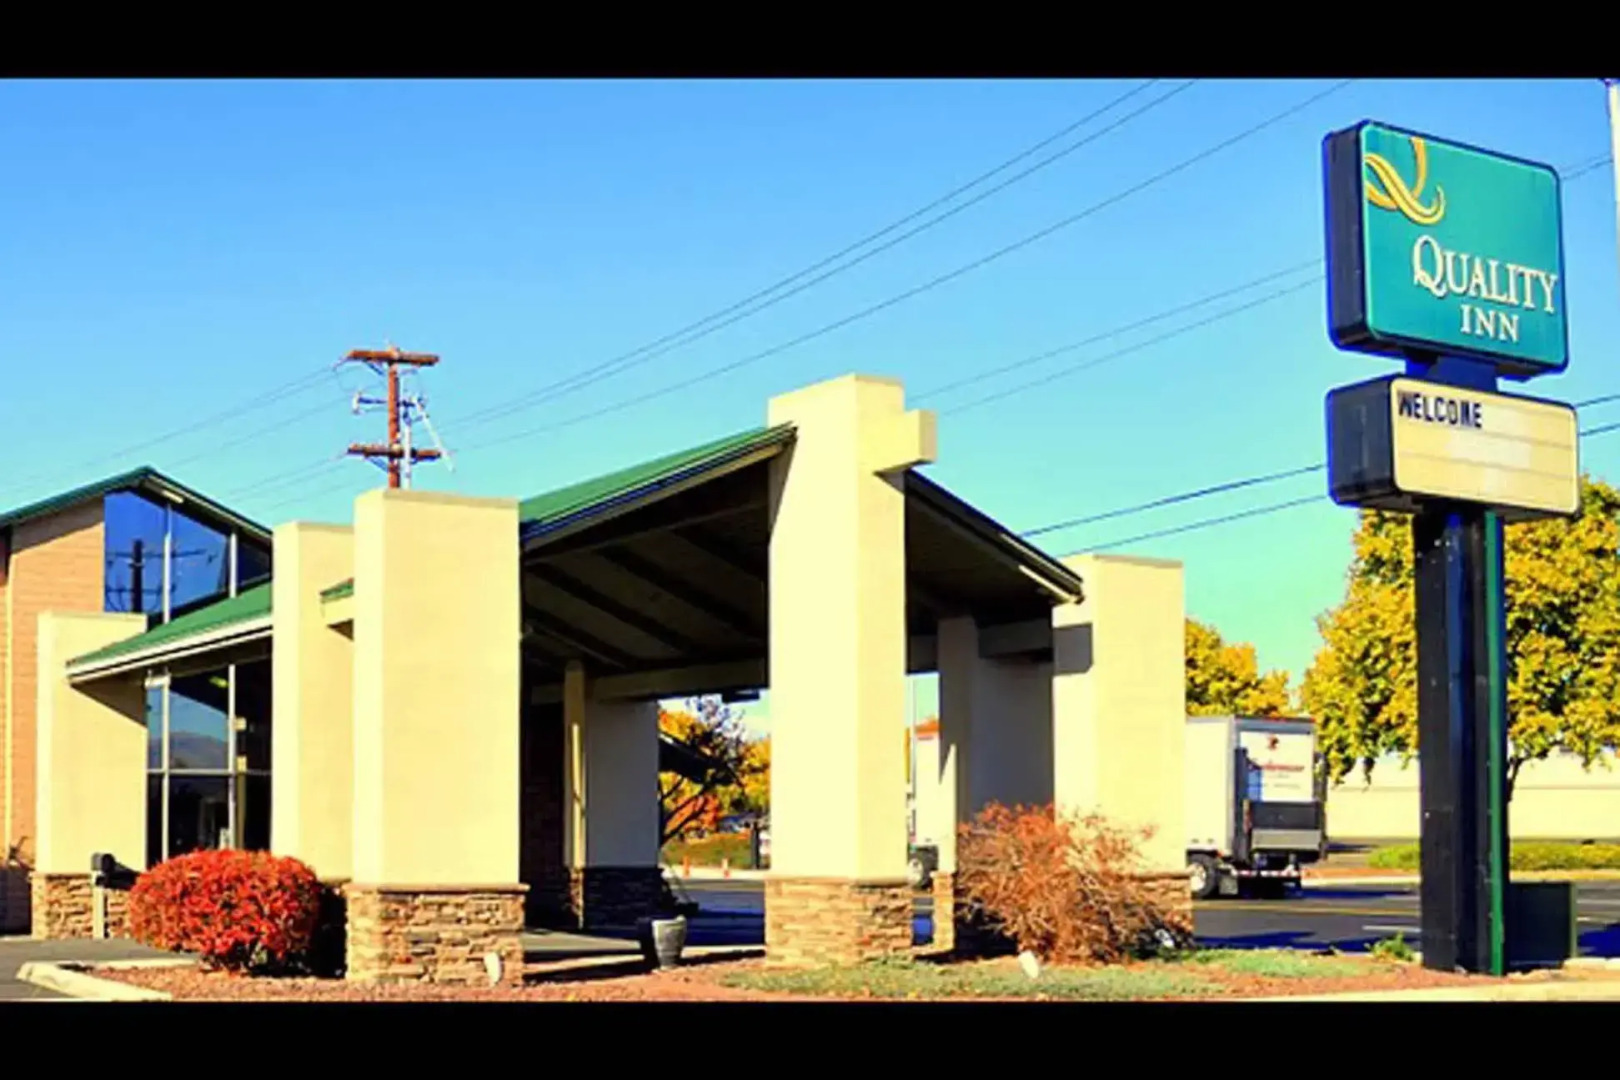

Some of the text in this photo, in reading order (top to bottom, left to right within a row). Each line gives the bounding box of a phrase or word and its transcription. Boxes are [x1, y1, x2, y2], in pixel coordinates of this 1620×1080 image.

[1413, 235, 1557, 313] QUALITY
[1461, 304, 1519, 342] INN
[1397, 391, 1482, 428] WELCOME
